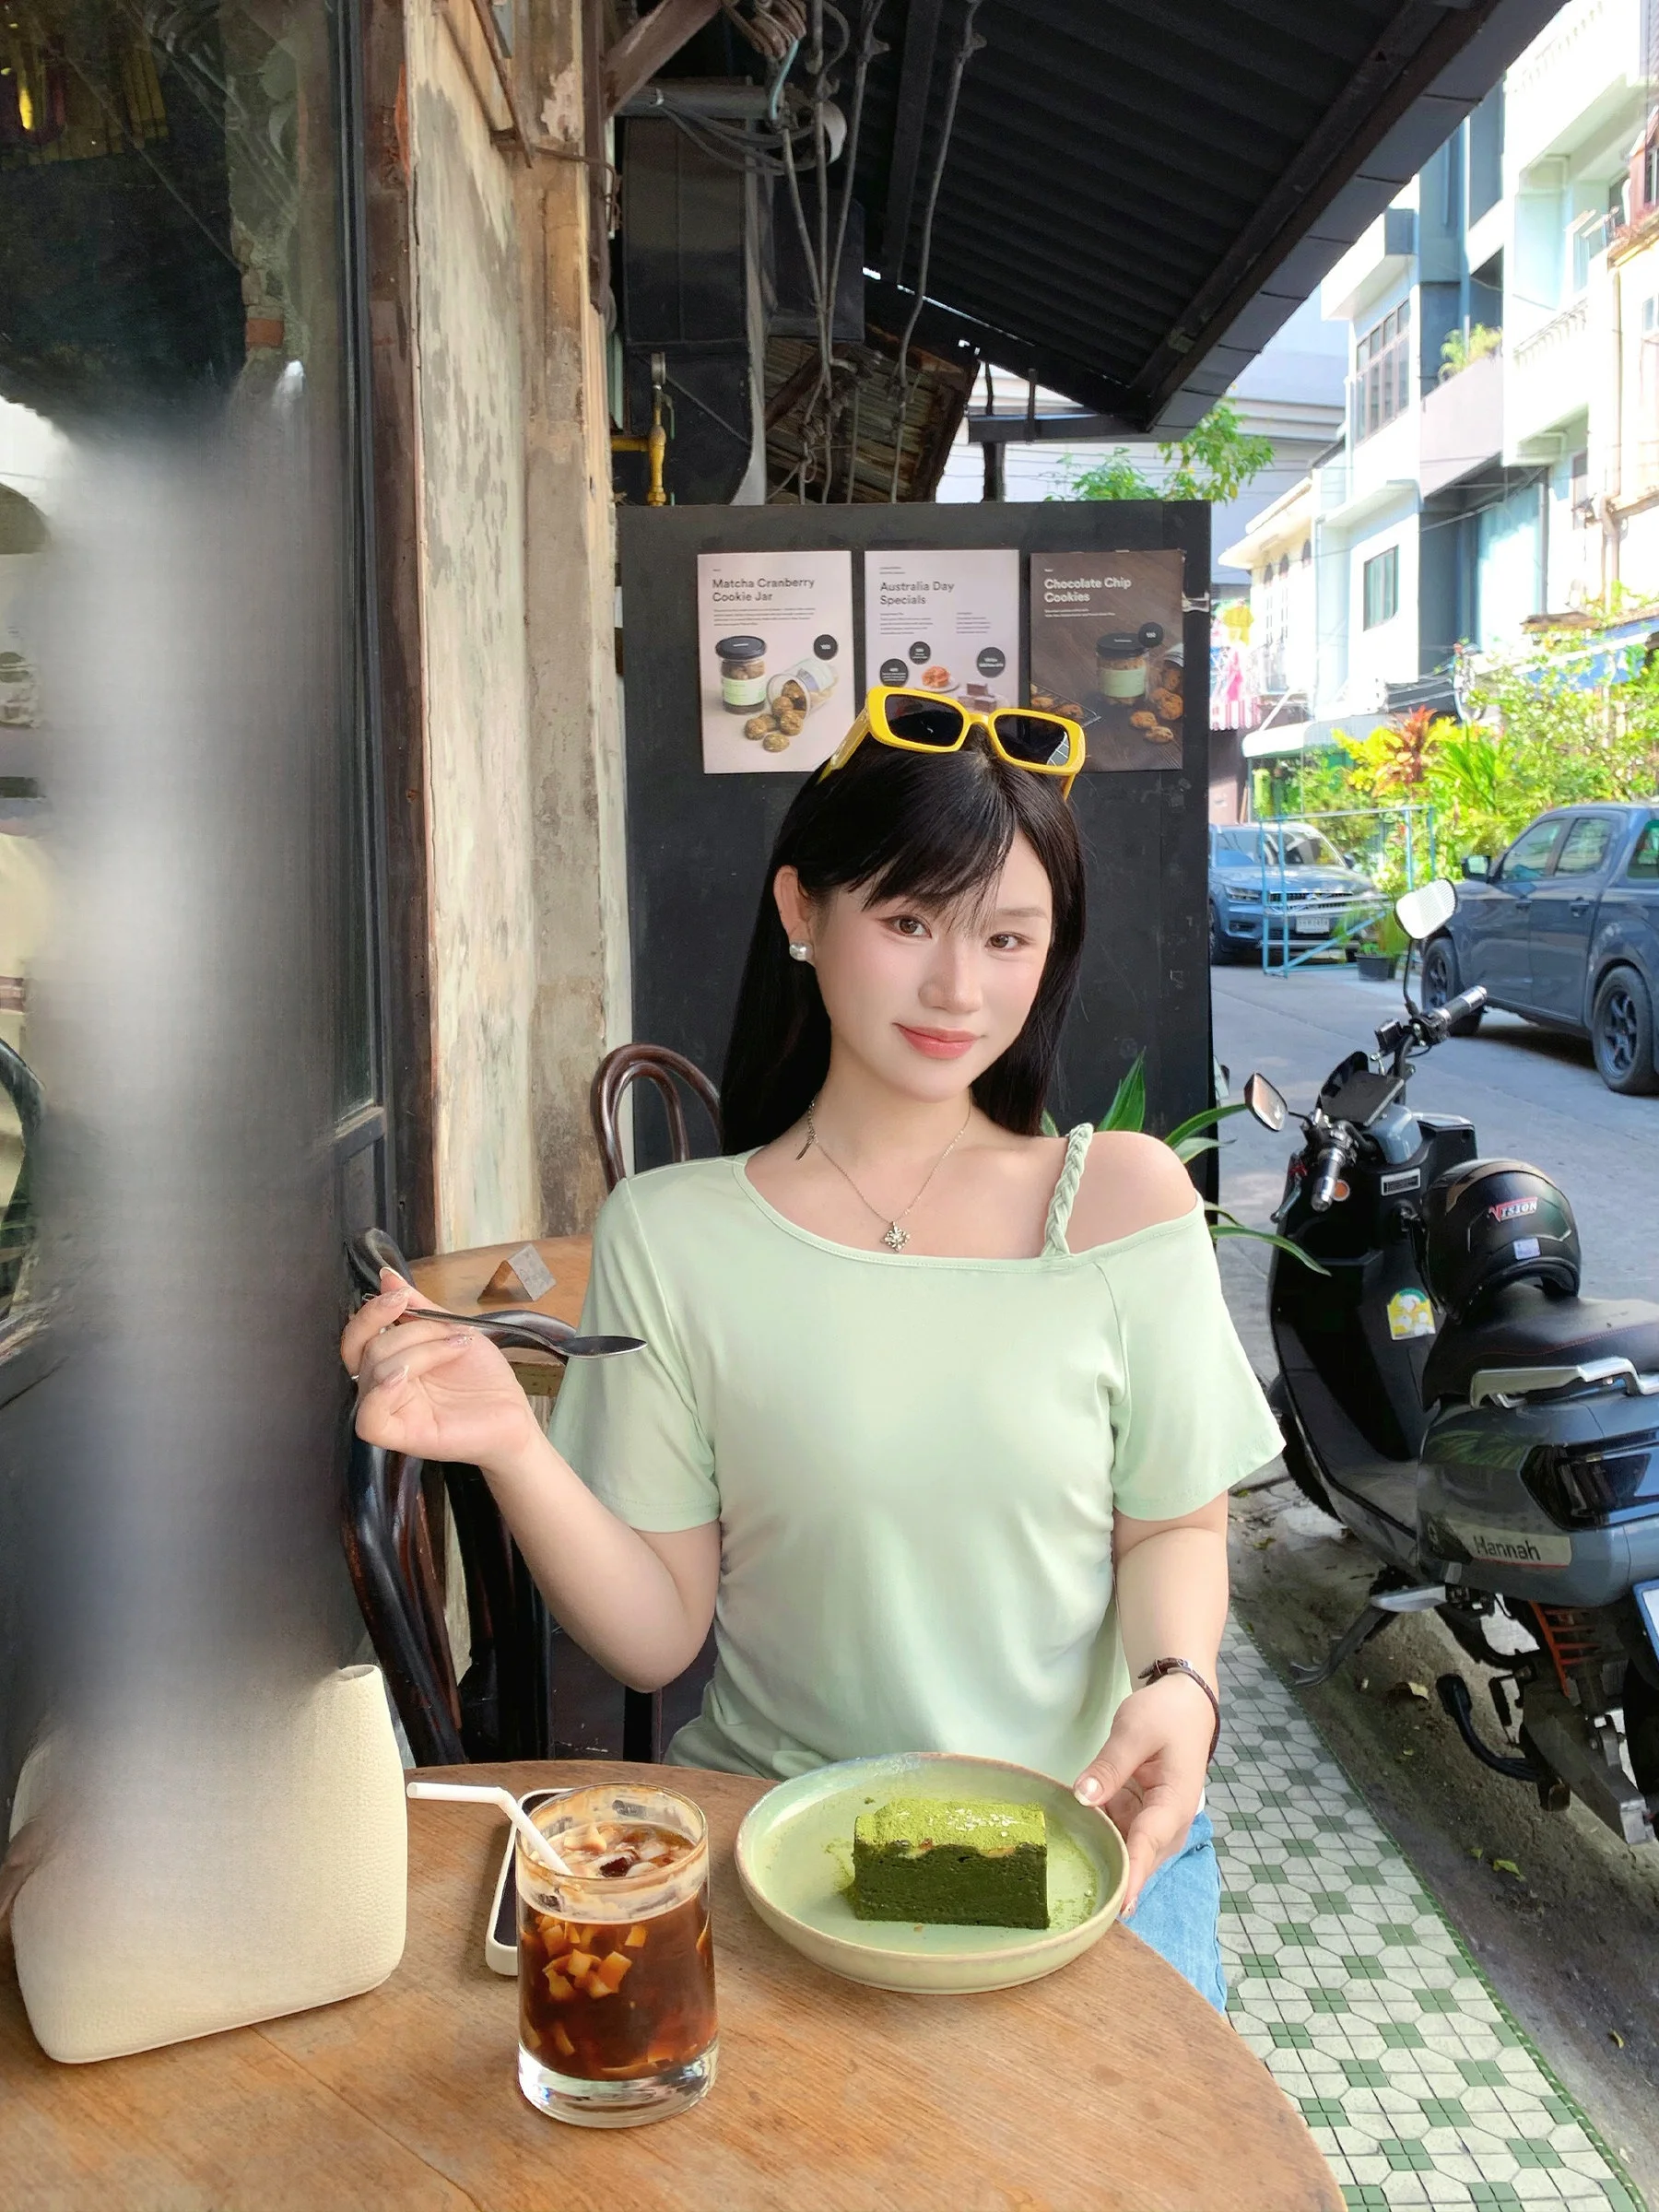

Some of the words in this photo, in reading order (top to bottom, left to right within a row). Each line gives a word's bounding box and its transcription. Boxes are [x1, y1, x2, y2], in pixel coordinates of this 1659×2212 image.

[712, 578, 755, 588] Matcha
[757, 578, 815, 589] Cranberry
[879, 581, 930, 592] Australia
[933, 581, 955, 593] Day
[1044, 578, 1101, 589] Chocolate
[1104, 577, 1132, 589] Chip
[712, 592, 752, 602] Cookie
[755, 591, 773, 602] Jar
[879, 594, 926, 606] Specials
[1044, 592, 1090, 602] Cookies
[1488, 1196, 1537, 1222] VISION
[1474, 1535, 1541, 1561] Hannah
